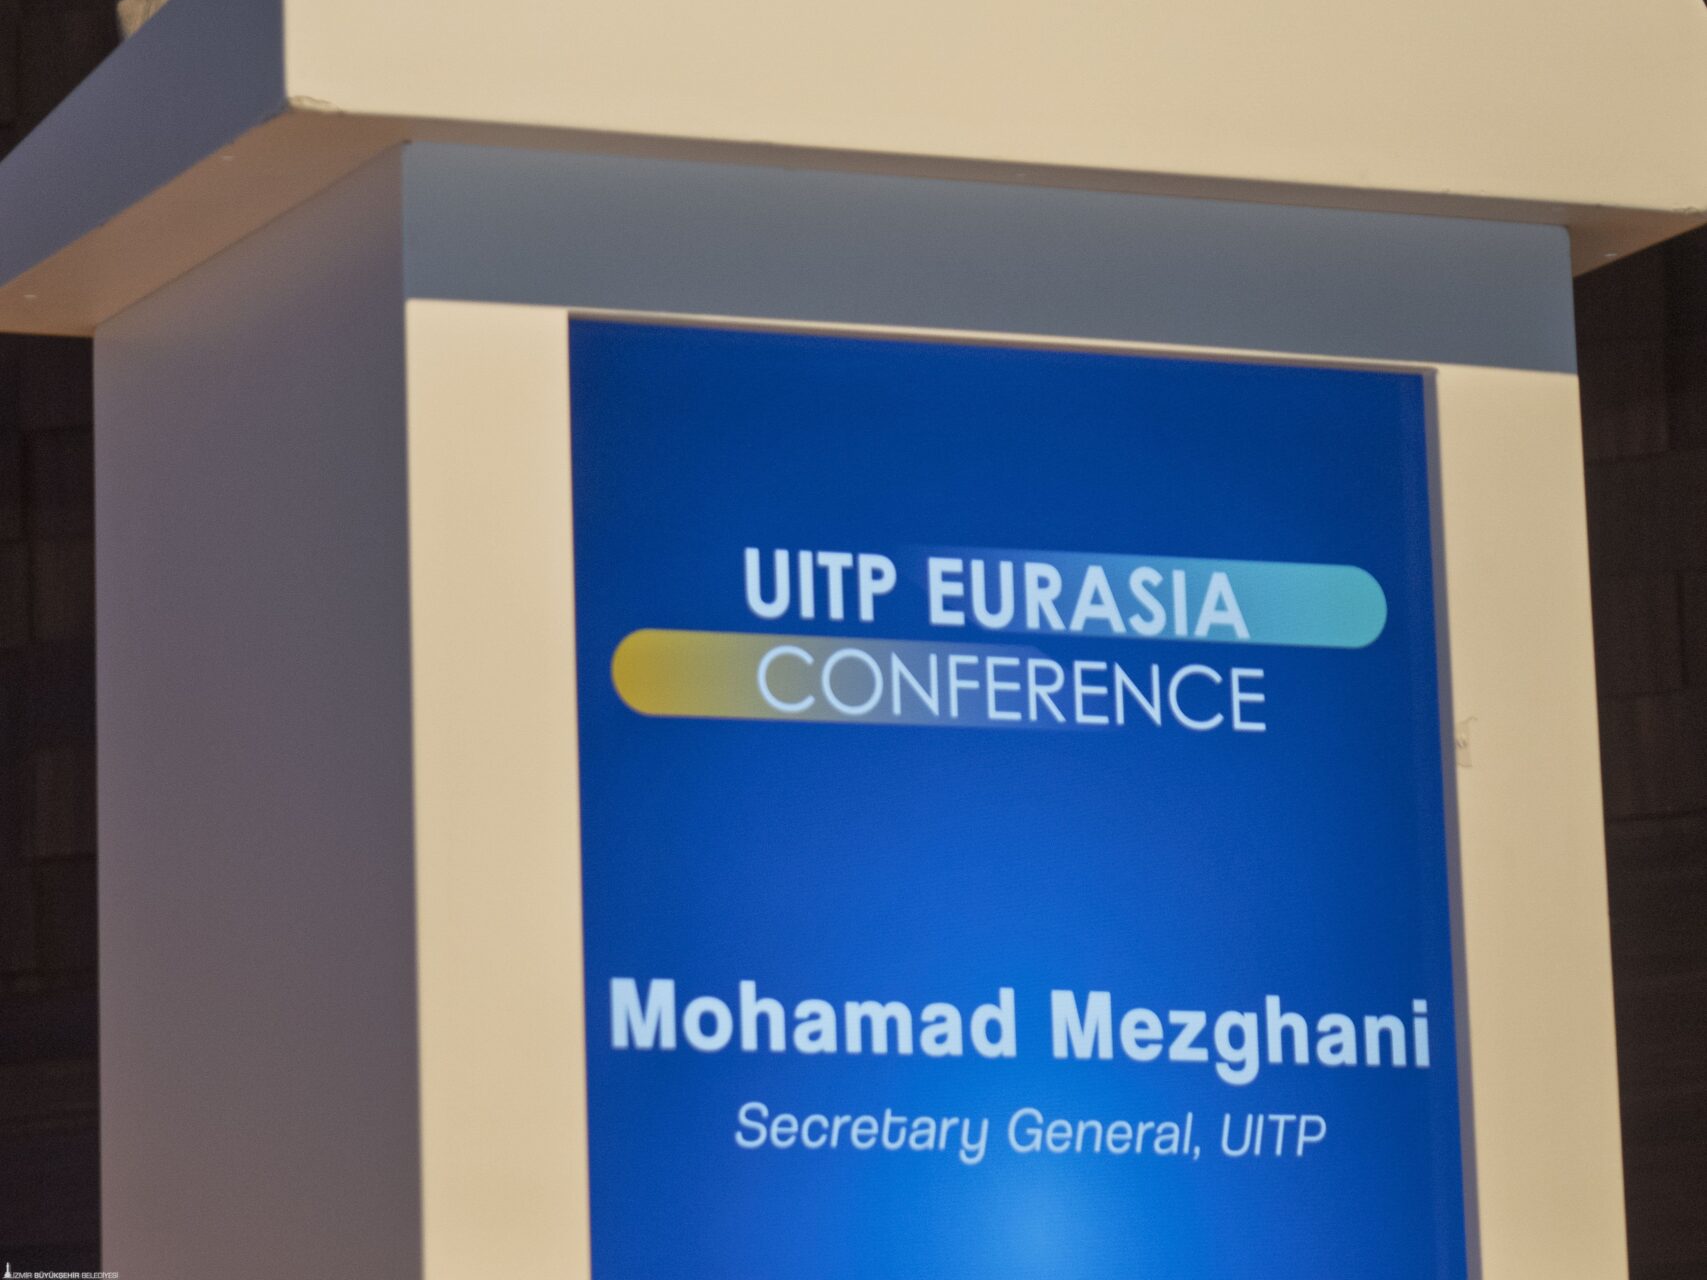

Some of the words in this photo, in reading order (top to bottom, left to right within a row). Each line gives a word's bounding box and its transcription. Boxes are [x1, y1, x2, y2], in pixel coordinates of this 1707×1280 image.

[744, 546, 898, 622] UITP
[927, 556, 1252, 641] EURASIA
[753, 643, 1267, 732] CONFERENCE
[610, 977, 1018, 1059] Mohamad
[1050, 988, 1431, 1086] Mezghani
[734, 1101, 990, 1166] Secretary
[1007, 1106, 1201, 1160] General,
[1220, 1112, 1328, 1158] UITP
